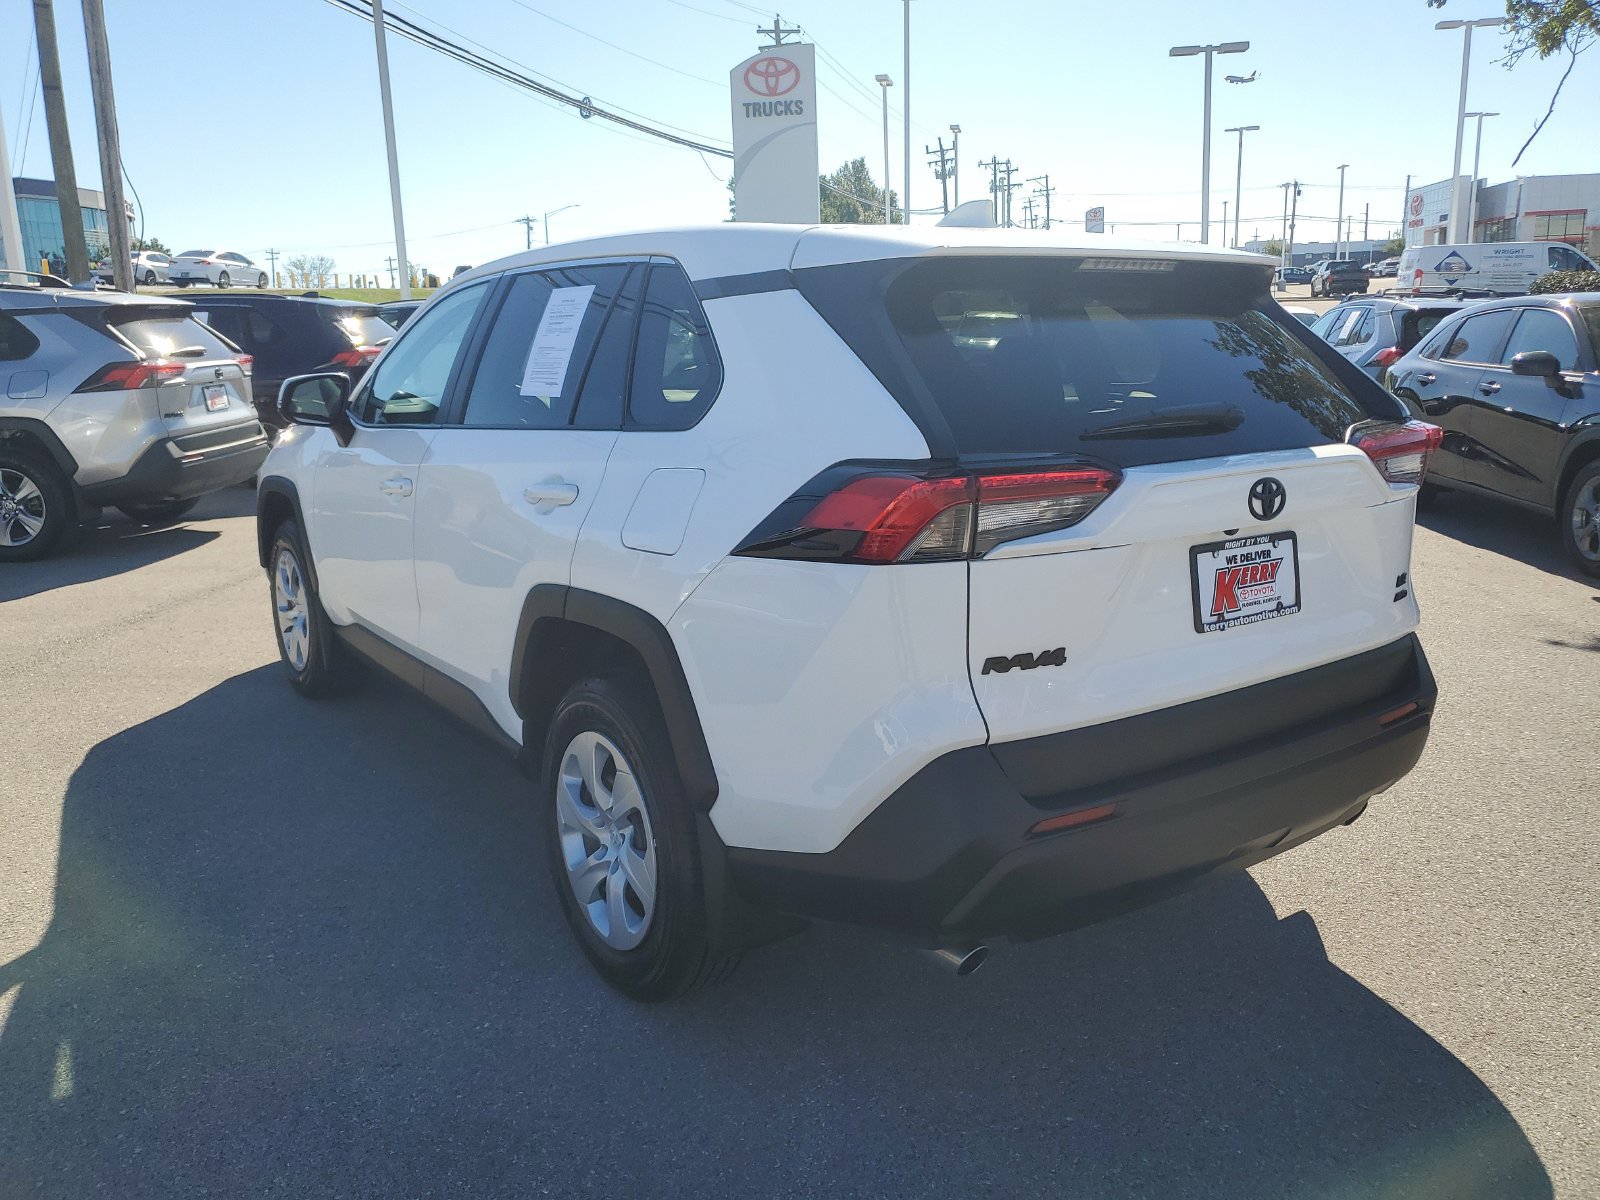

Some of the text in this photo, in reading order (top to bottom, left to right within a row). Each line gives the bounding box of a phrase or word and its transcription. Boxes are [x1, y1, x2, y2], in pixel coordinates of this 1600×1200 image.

[742, 99, 804, 118] TRUCKS
[1224, 535, 1270, 550] RIGHT BY YOU
[1225, 549, 1272, 565] WE DELIVER
[1249, 585, 1275, 597] TOYOTA
[1203, 605, 1299, 633] kerryautomotive.com
[981, 647, 1067, 675] RAV4
